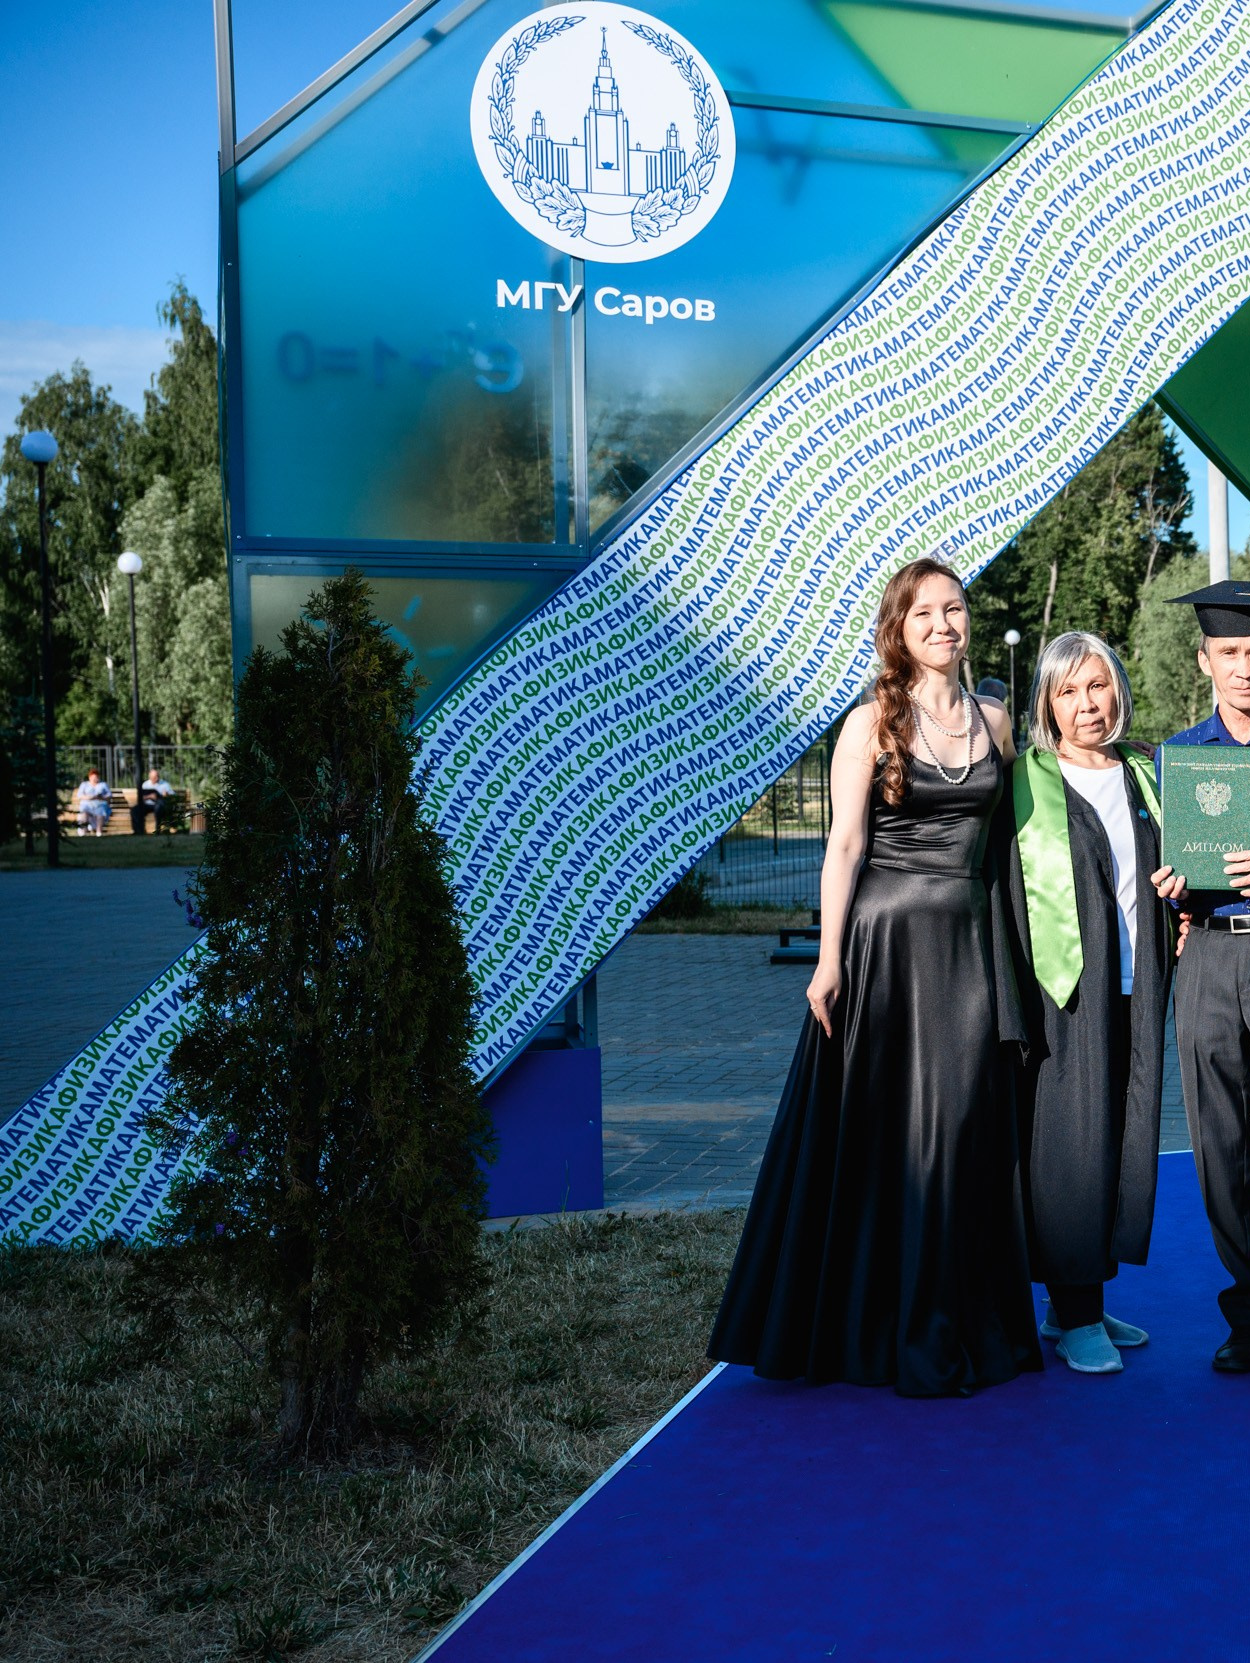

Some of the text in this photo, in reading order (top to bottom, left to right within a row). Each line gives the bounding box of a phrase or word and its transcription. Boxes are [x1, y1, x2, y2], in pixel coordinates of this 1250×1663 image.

[496, 279, 716, 325] МГУ Саров
[1182, 842, 1243, 853] ДИПЛОМ
